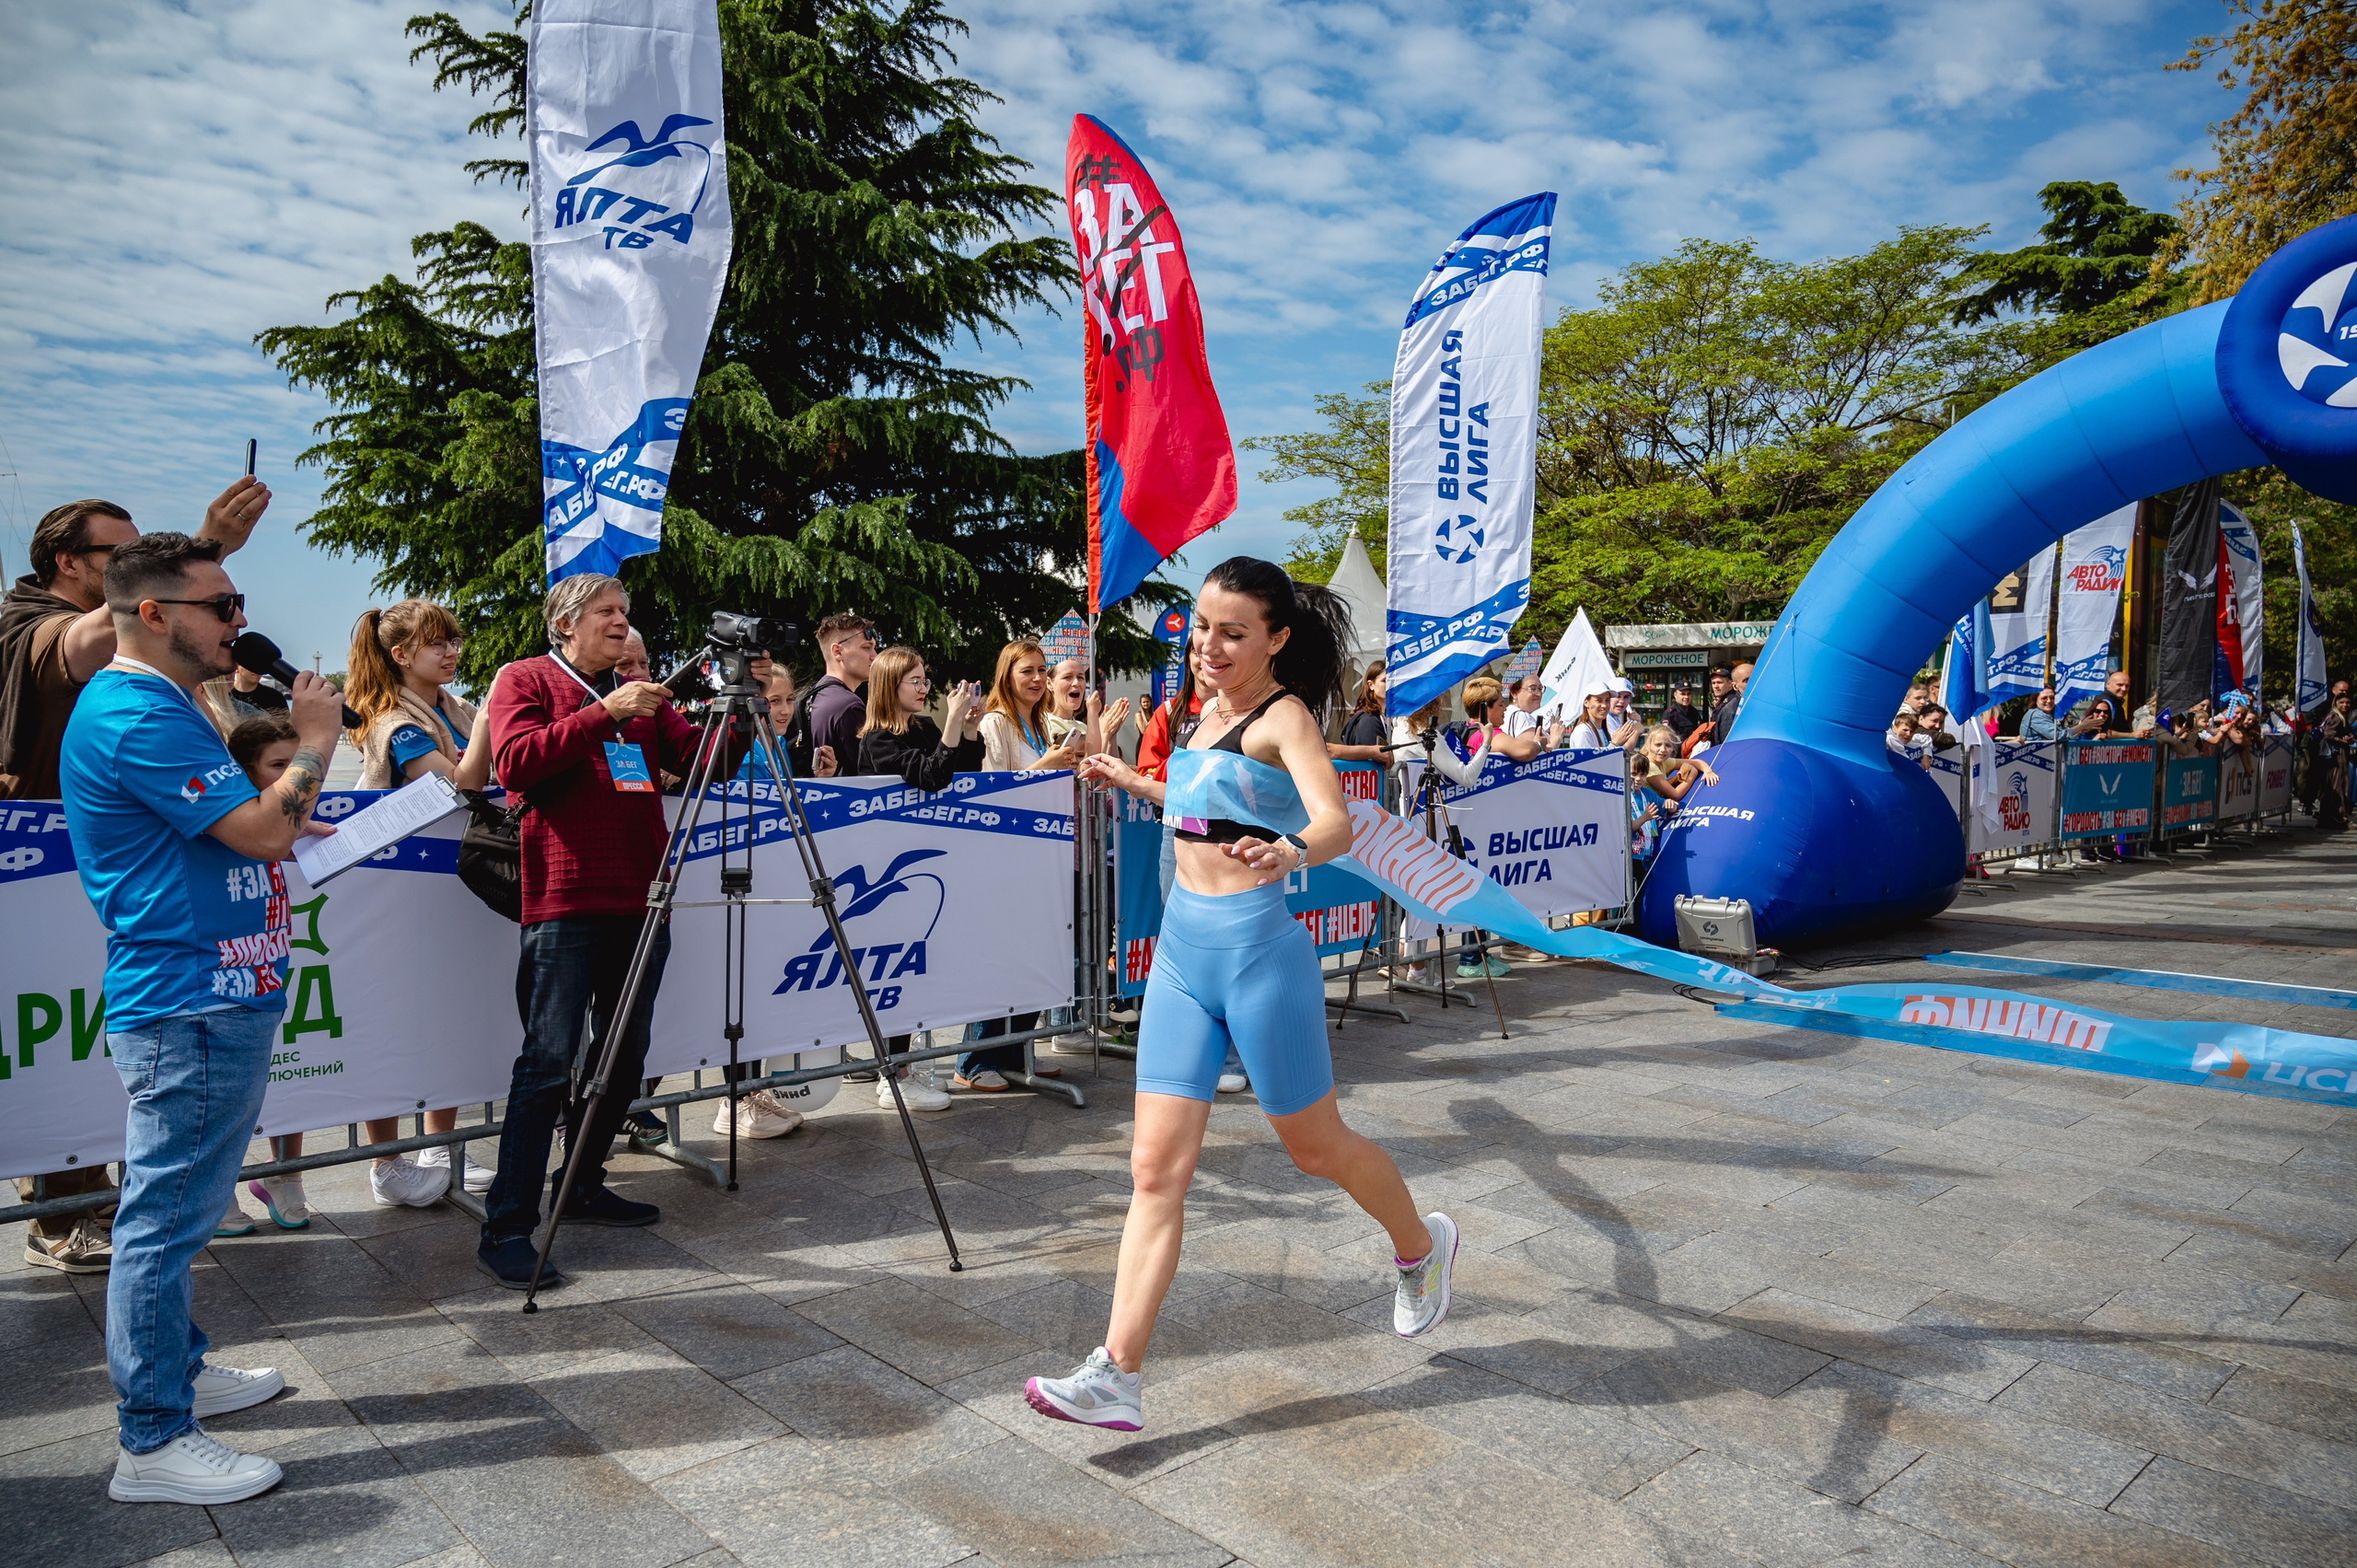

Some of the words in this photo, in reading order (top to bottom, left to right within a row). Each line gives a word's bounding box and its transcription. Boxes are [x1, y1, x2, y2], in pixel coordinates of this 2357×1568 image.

[554, 187, 694, 245] ЯЛТА
[602, 226, 655, 250] ТВ
[1438, 331, 1463, 501] ВЫСШАЯ
[1467, 401, 1490, 505] ЛИГА
[2067, 563, 2107, 579] АВТО
[1631, 653, 1703, 666] МОРОЖЕНОЕ
[1514, 750, 1575, 778] ЗАБЕГ.РФ
[2092, 745, 2124, 764] #ВОСТОРГ
[2124, 745, 2154, 763] #МОМЕНТ
[204, 761, 243, 786] ПСБ
[1538, 770, 1587, 785] БЕГ.РФ
[900, 805, 1001, 827] БЕГ.РФ
[1998, 796, 2020, 815] АВТО
[2003, 812, 2031, 831] РАДИО
[670, 814, 803, 858] АБЕГ.РФ
[1488, 823, 1599, 857] ВЫСШАЯ
[1489, 858, 1552, 888] ЛИГА
[772, 940, 927, 995] ЯЛТА
[270, 1051, 301, 1066] ДЕС
[267, 1060, 344, 1084] ЛЮЧЕНИЙ
